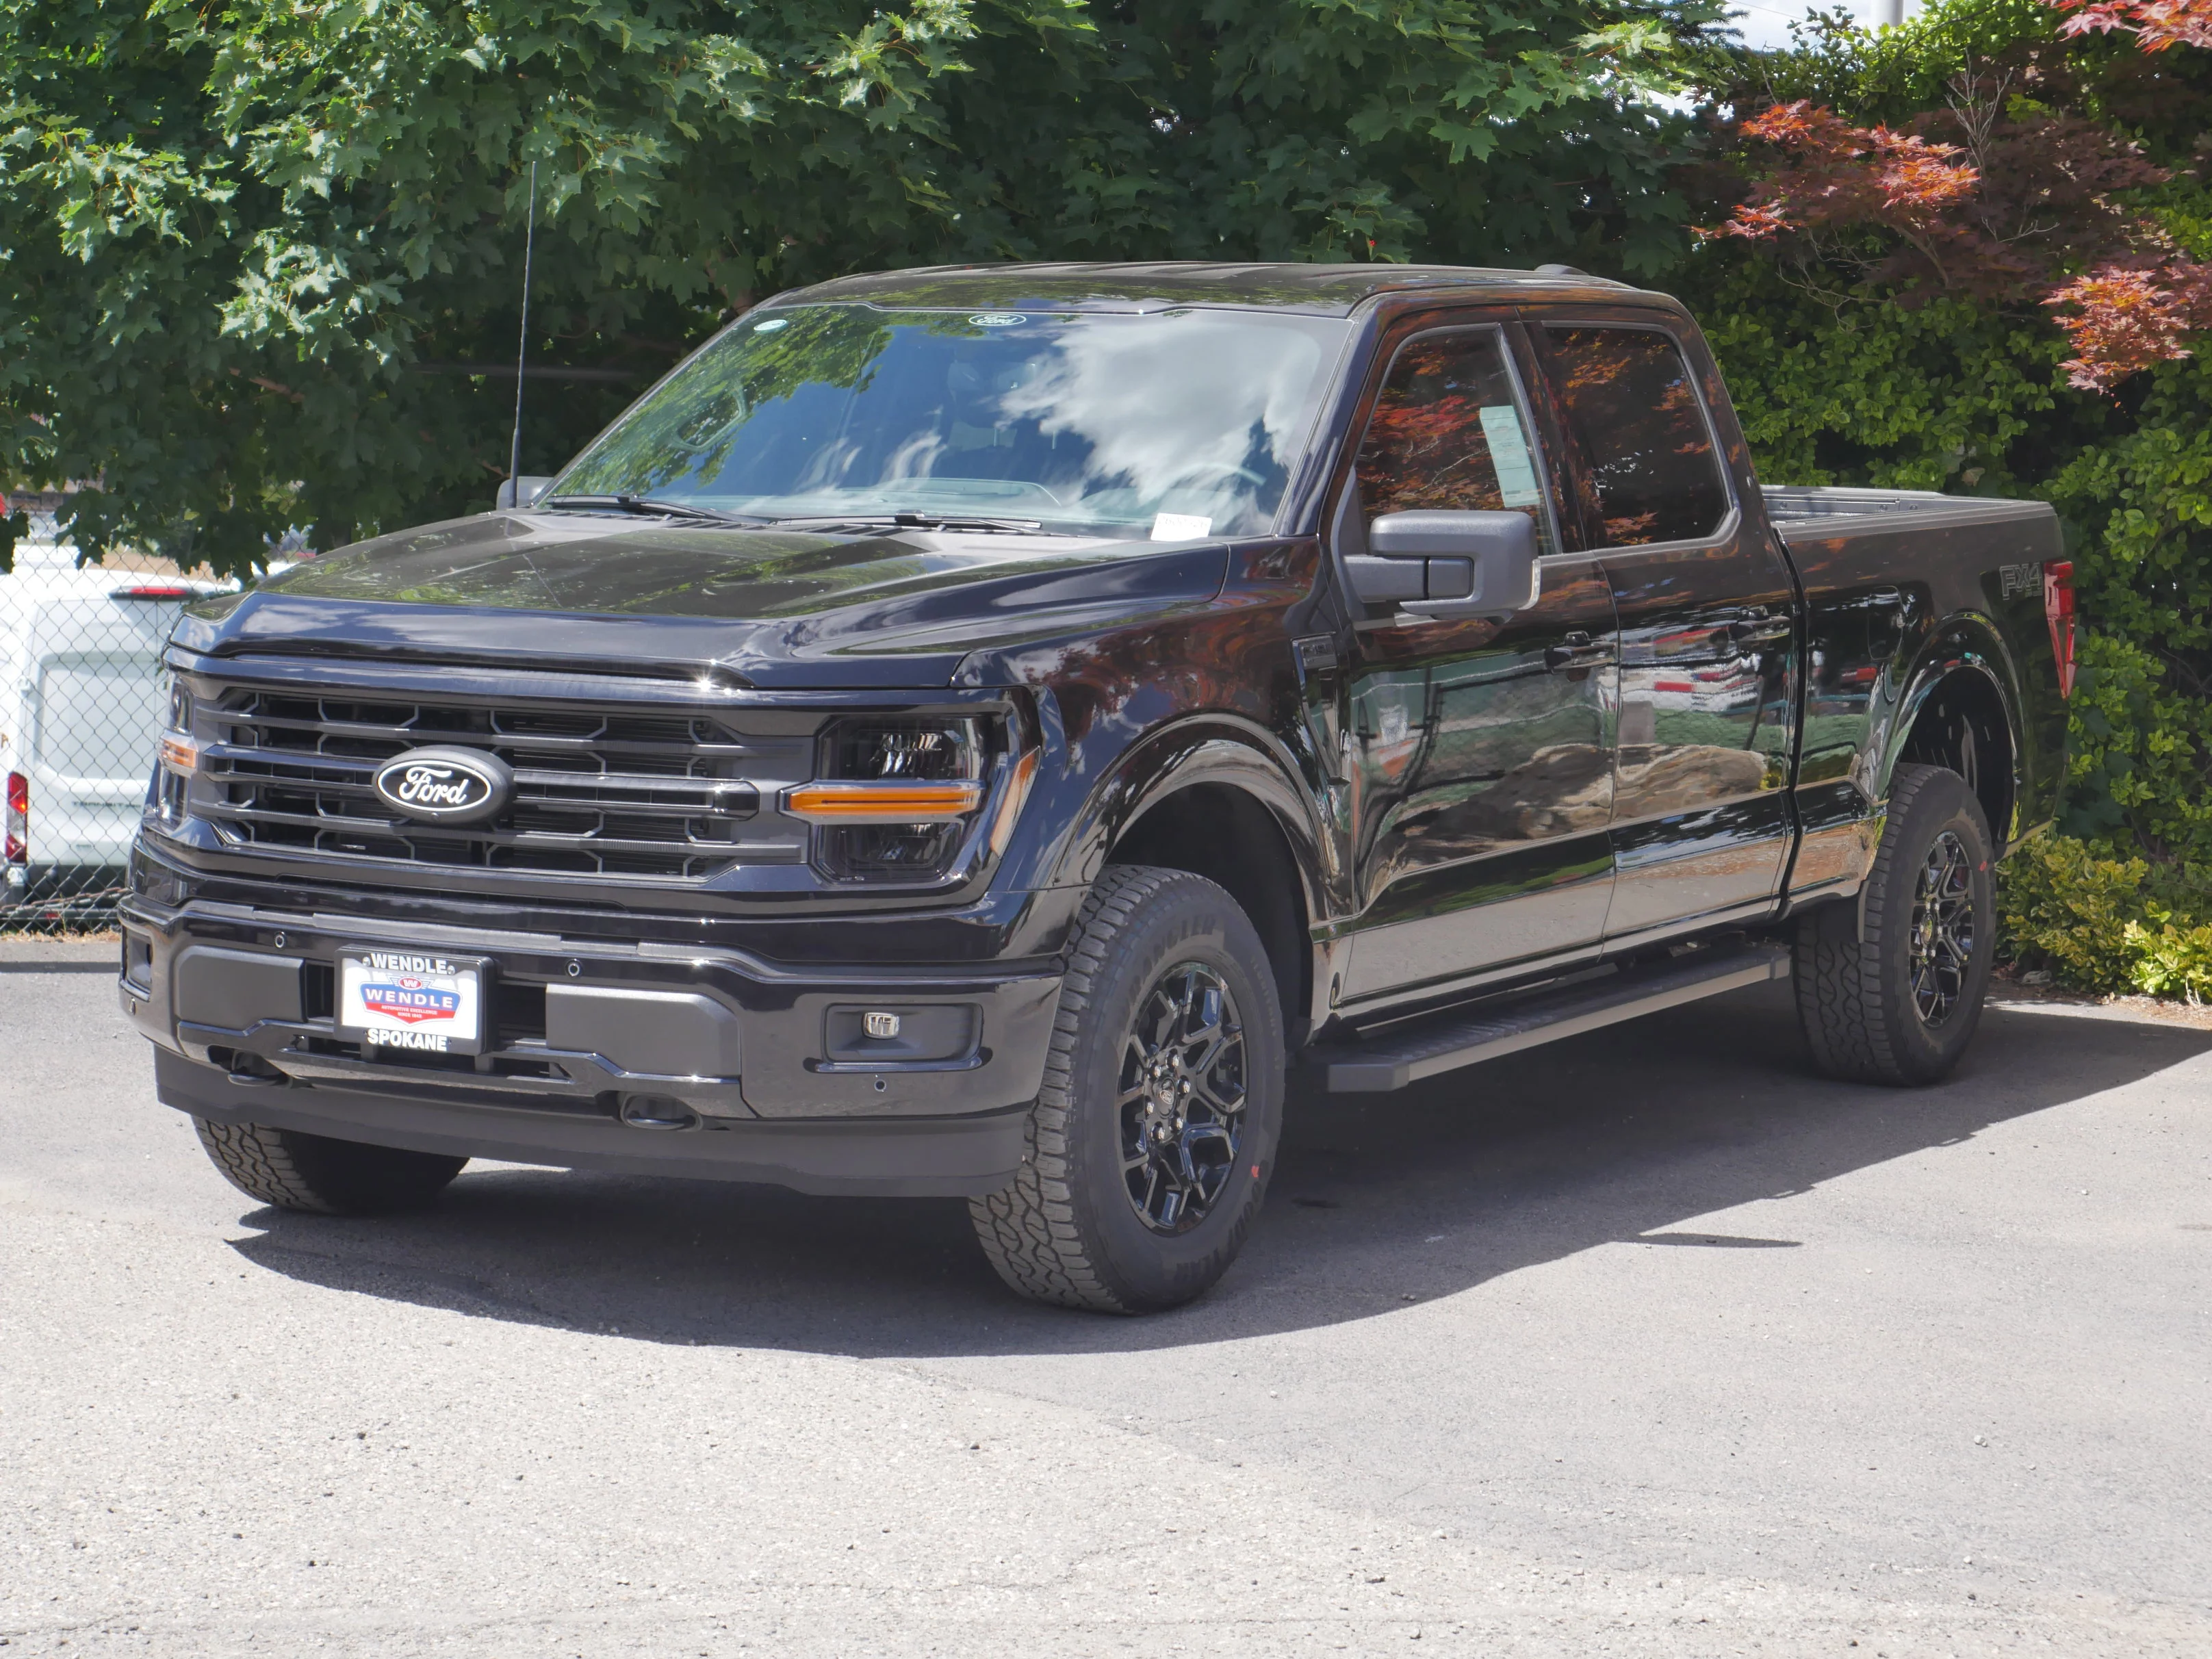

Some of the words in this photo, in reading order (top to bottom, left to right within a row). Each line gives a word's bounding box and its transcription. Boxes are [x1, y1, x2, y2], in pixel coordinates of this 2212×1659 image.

[977, 314, 1017, 324] Ford
[1999, 562, 2043, 600] FX4
[398, 766, 470, 804] Ford
[370, 953, 448, 975] WENDLE
[402, 979, 418, 988] W
[365, 988, 453, 1008] WENDLE
[367, 1028, 448, 1051] SPOKANE
